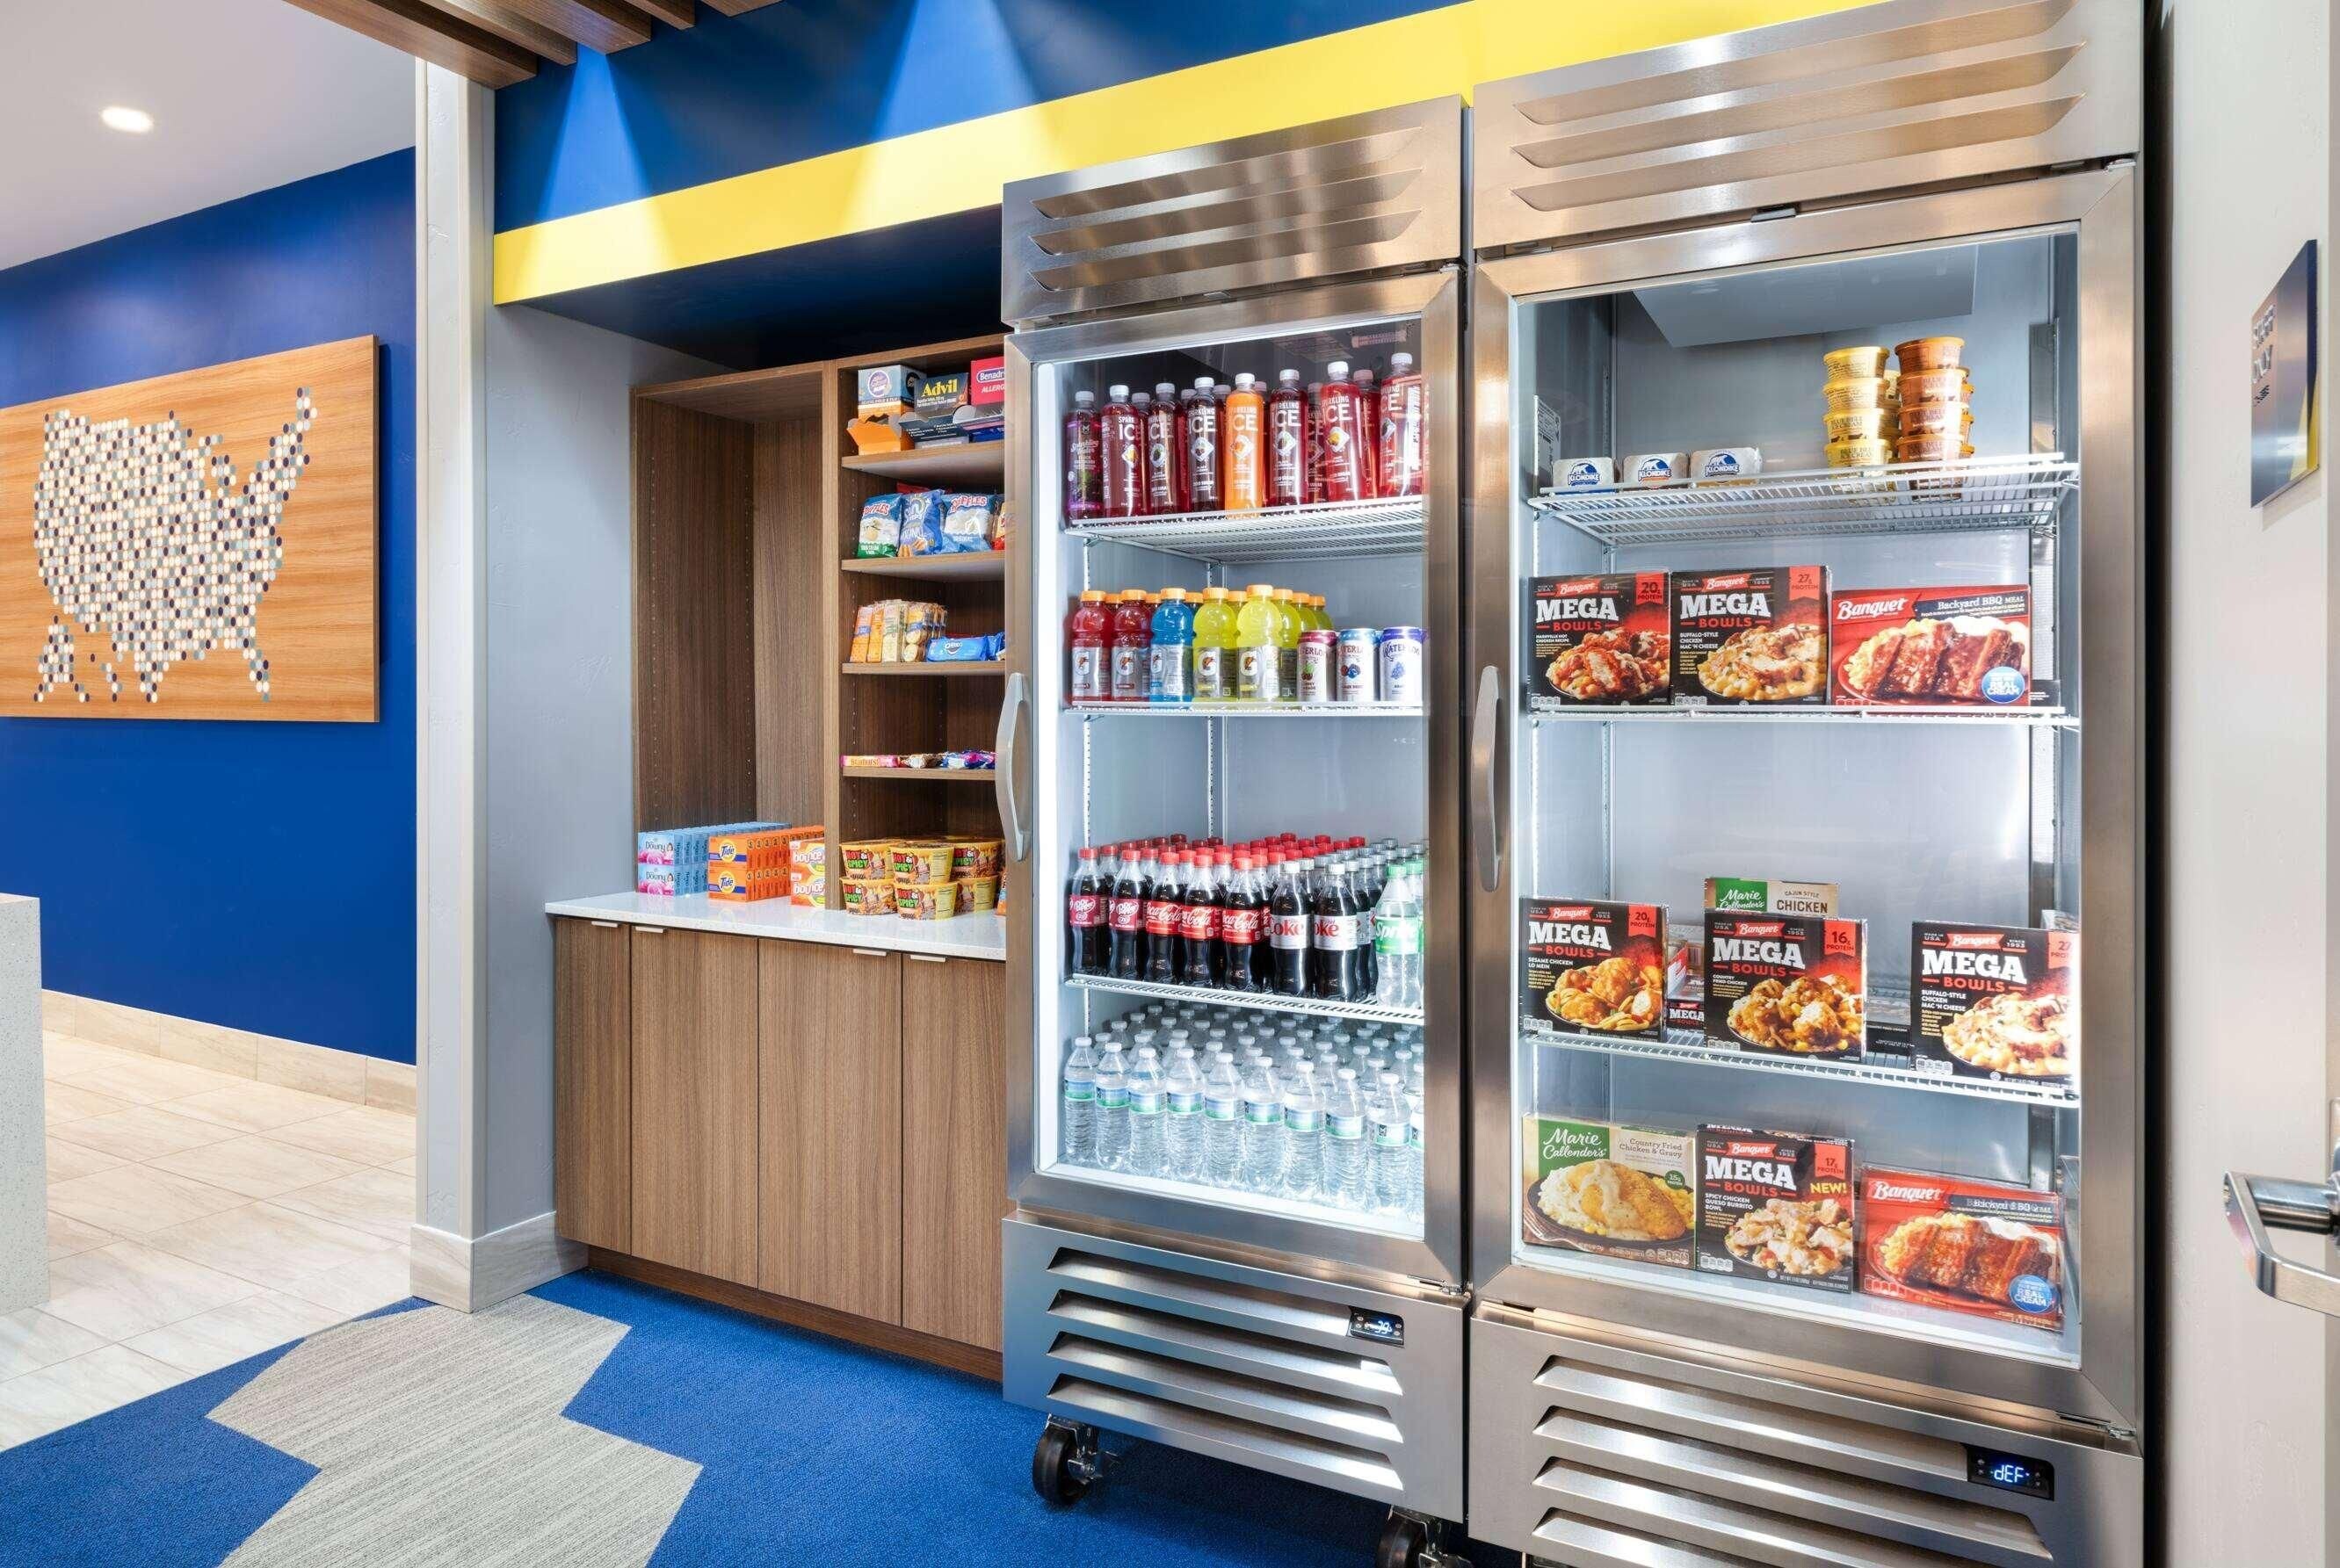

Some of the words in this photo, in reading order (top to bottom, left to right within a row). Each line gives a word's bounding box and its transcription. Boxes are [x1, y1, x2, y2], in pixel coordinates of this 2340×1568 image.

[921, 379, 958, 398] Advil
[1568, 473, 1601, 481] KLONDIKE
[1638, 467, 1672, 481] KLONDIKE
[1705, 464, 1740, 477] KLONDIKE
[1706, 577, 1747, 589] Banquet
[1680, 592, 1771, 620] MEGA
[1837, 597, 1909, 620] Banquet
[1938, 600, 1979, 611] Backyard
[1982, 596, 2003, 605] BBQ
[1536, 597, 1619, 624] MEGA
[1553, 621, 1602, 632] BOWLS
[1699, 617, 1752, 628] BOWLS
[645, 841, 666, 853] Downy
[721, 845, 735, 858] Tide
[793, 850, 823, 863] bounce
[846, 850, 861, 859] HOT
[893, 853, 906, 863] HOT
[847, 860, 868, 869] SPICY
[894, 863, 913, 872] SPICY
[646, 871, 666, 884] Downy
[720, 876, 734, 889] Tide
[793, 882, 825, 895] bounce
[844, 884, 856, 894] HOT
[897, 889, 912, 898] HOT
[1721, 889, 1761, 901] Marie
[898, 899, 919, 908] SPICY
[1776, 900, 1829, 914] CHICKEN
[1553, 907, 1588, 921] Banquet
[1271, 919, 1304, 936] oke
[1739, 923, 1779, 936] Banquet
[1528, 921, 1612, 950] MEGA
[1546, 945, 1594, 957] BOWLS
[1713, 937, 1806, 970] MEGA
[1732, 964, 1786, 978] BOWLS
[1922, 949, 2027, 984] MEGA
[1944, 977, 2005, 993] BOWLS
[1922, 989, 1967, 1000] BUFFALO-STYLE
[1670, 1008, 1705, 1022] MEGA
[1543, 1128, 1603, 1145] Marie
[1630, 1138, 1660, 1148] Country
[1543, 1145, 1604, 1160] Callender's
[1619, 1144, 1650, 1154] Chicken
[1659, 1149, 1683, 1160] Gravy
[1732, 1143, 1771, 1155] Banquet
[1705, 1155, 1797, 1190] MEGA
[1725, 1182, 1779, 1197] BOWLS
[1810, 1182, 1848, 1195] NEW!
[1873, 1180, 1945, 1201] Banquet
[1994, 1464, 2025, 1483] dEF
